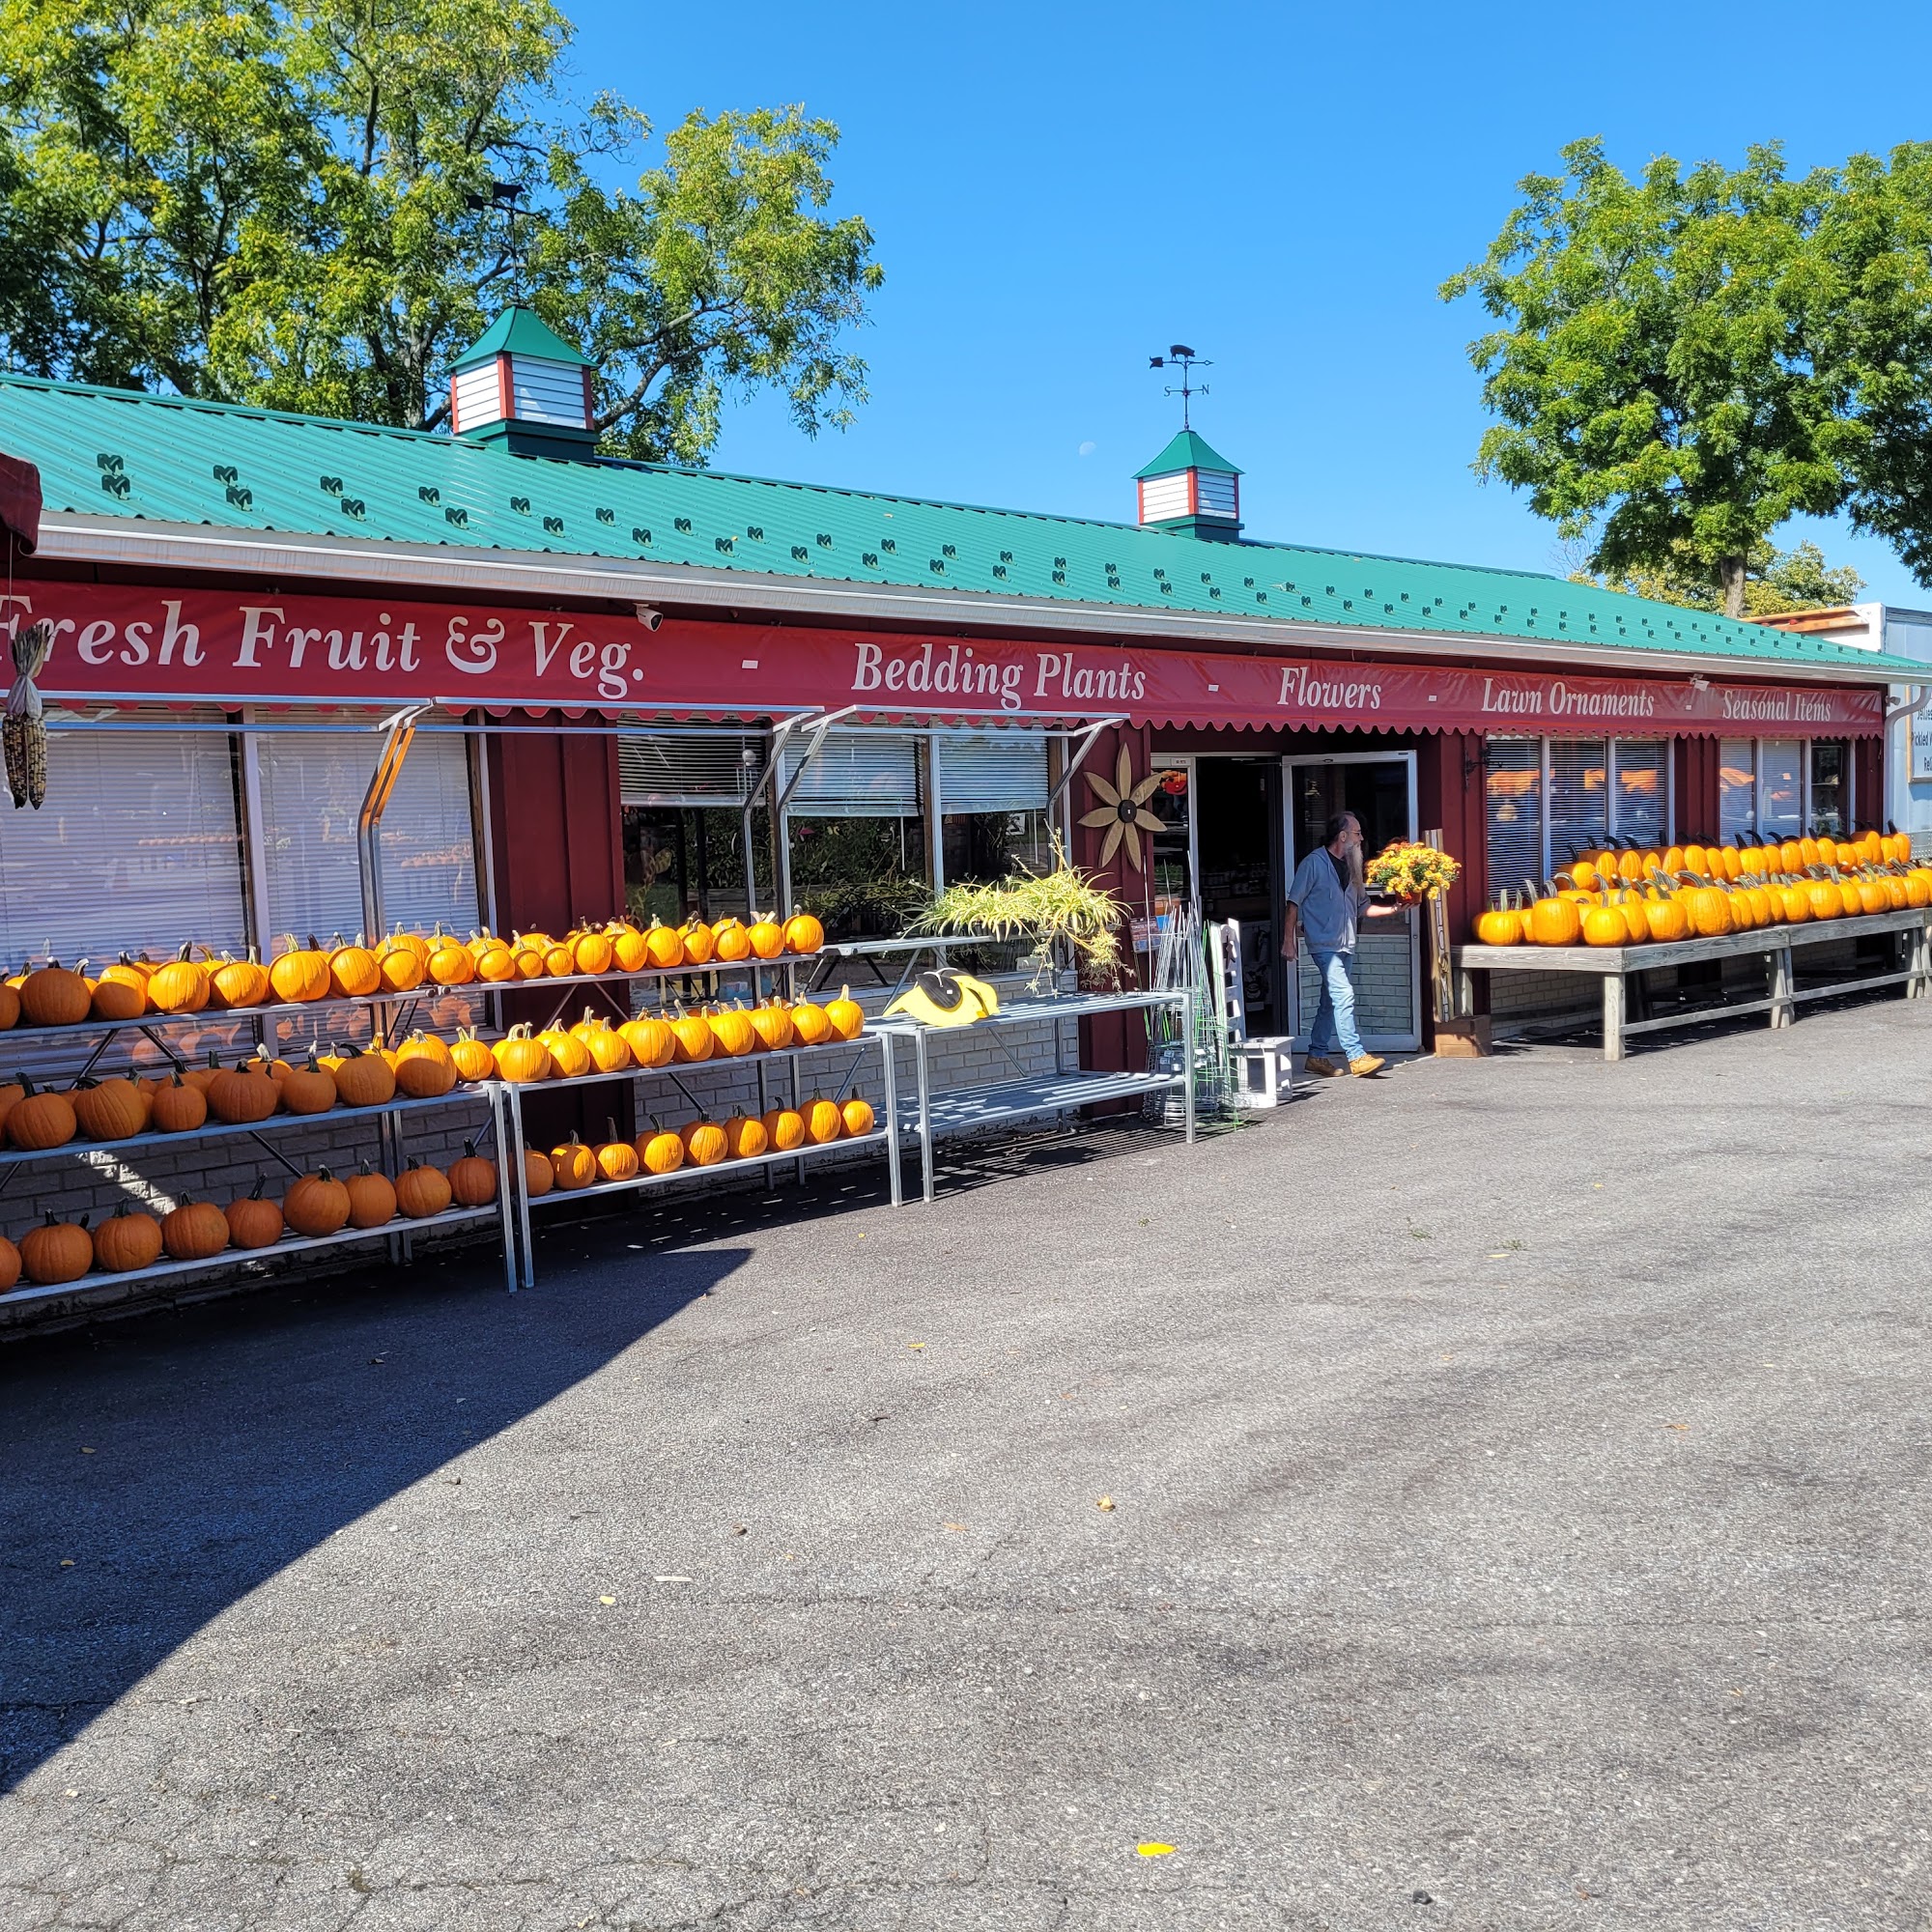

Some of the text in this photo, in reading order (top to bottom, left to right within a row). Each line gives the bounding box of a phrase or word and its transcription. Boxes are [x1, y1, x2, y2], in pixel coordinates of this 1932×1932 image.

[232, 606, 421, 672] Fruit
[445, 615, 505, 674] &
[528, 621, 644, 699] Veg.
[851, 642, 1024, 711] Bedding
[1034, 652, 1147, 700] Plants
[1277, 667, 1381, 710] Flowers
[1481, 677, 1542, 715] Lawn
[1549, 681, 1655, 717] Ornaments
[1722, 690, 1790, 721] Seasonal
[1793, 694, 1832, 722] Items
